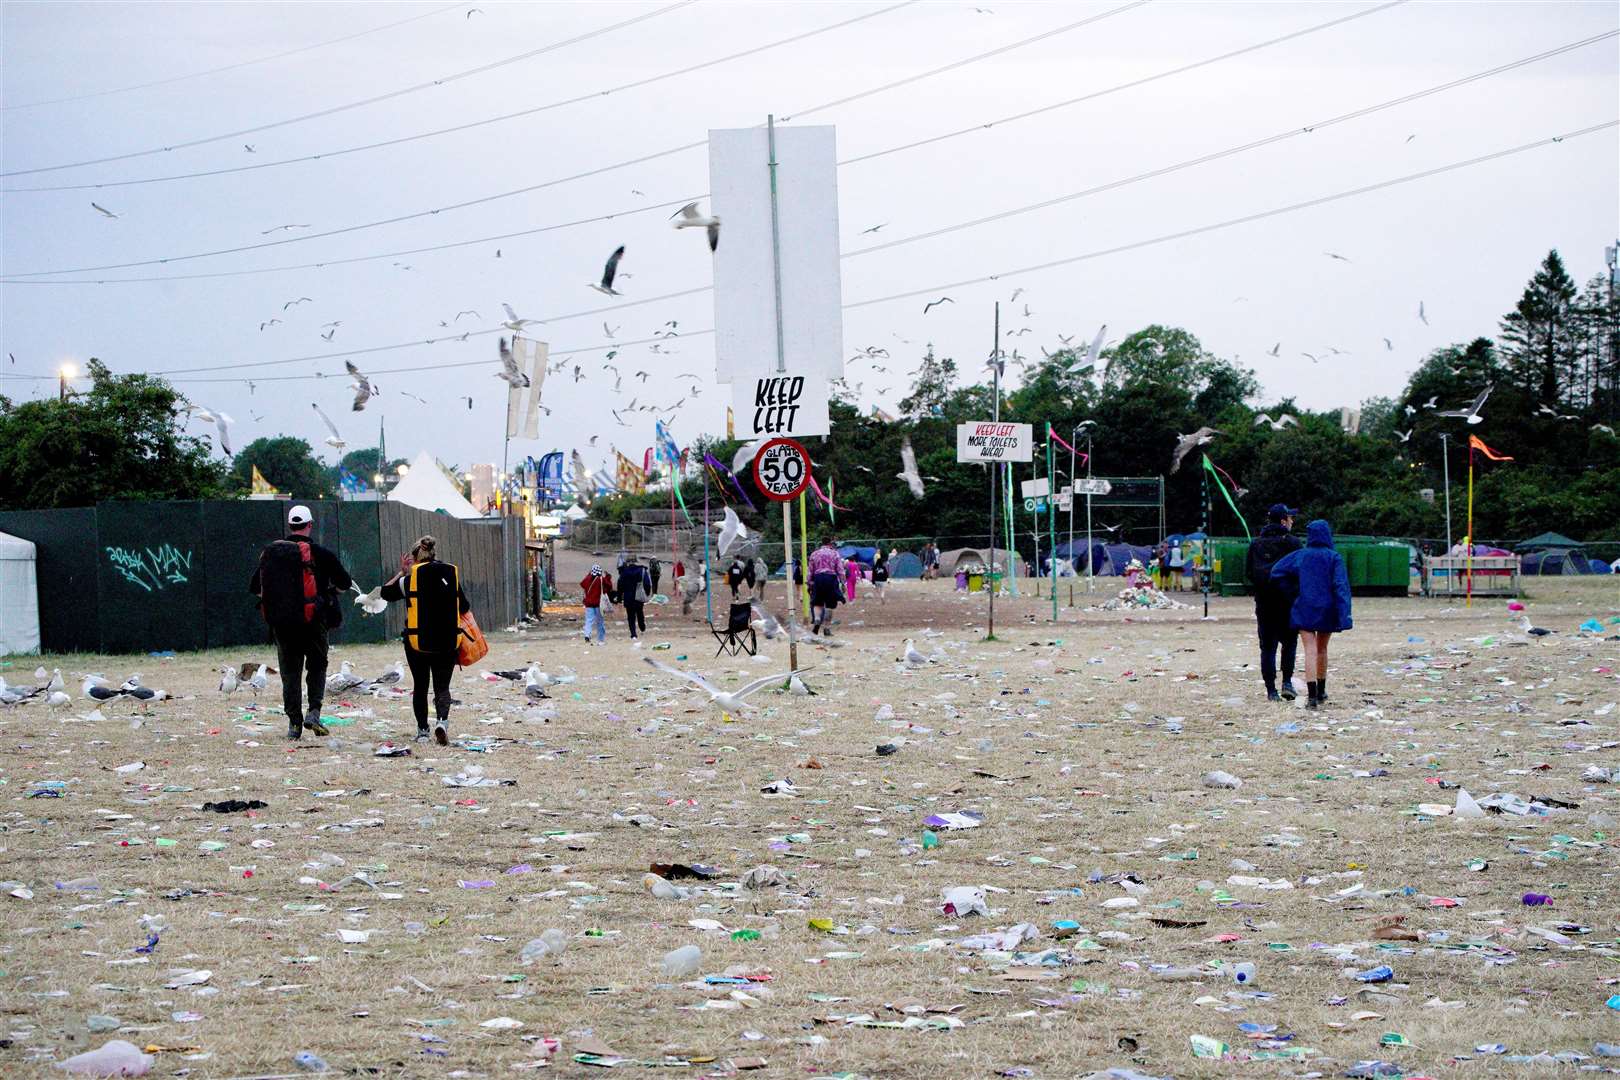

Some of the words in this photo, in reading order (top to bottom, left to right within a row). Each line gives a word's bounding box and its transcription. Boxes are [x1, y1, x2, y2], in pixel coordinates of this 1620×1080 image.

[755, 376, 805, 407] KEEP
[753, 405, 800, 434] LEFT
[976, 424, 995, 436] KEEP
[996, 425, 1015, 437] LEFT
[967, 435, 987, 447] MORE
[989, 436, 1018, 448] TOILETS
[766, 444, 800, 458] GLASTO
[980, 447, 1004, 458] AHEAD
[763, 457, 803, 482] 50
[767, 480, 801, 493] YEARS
